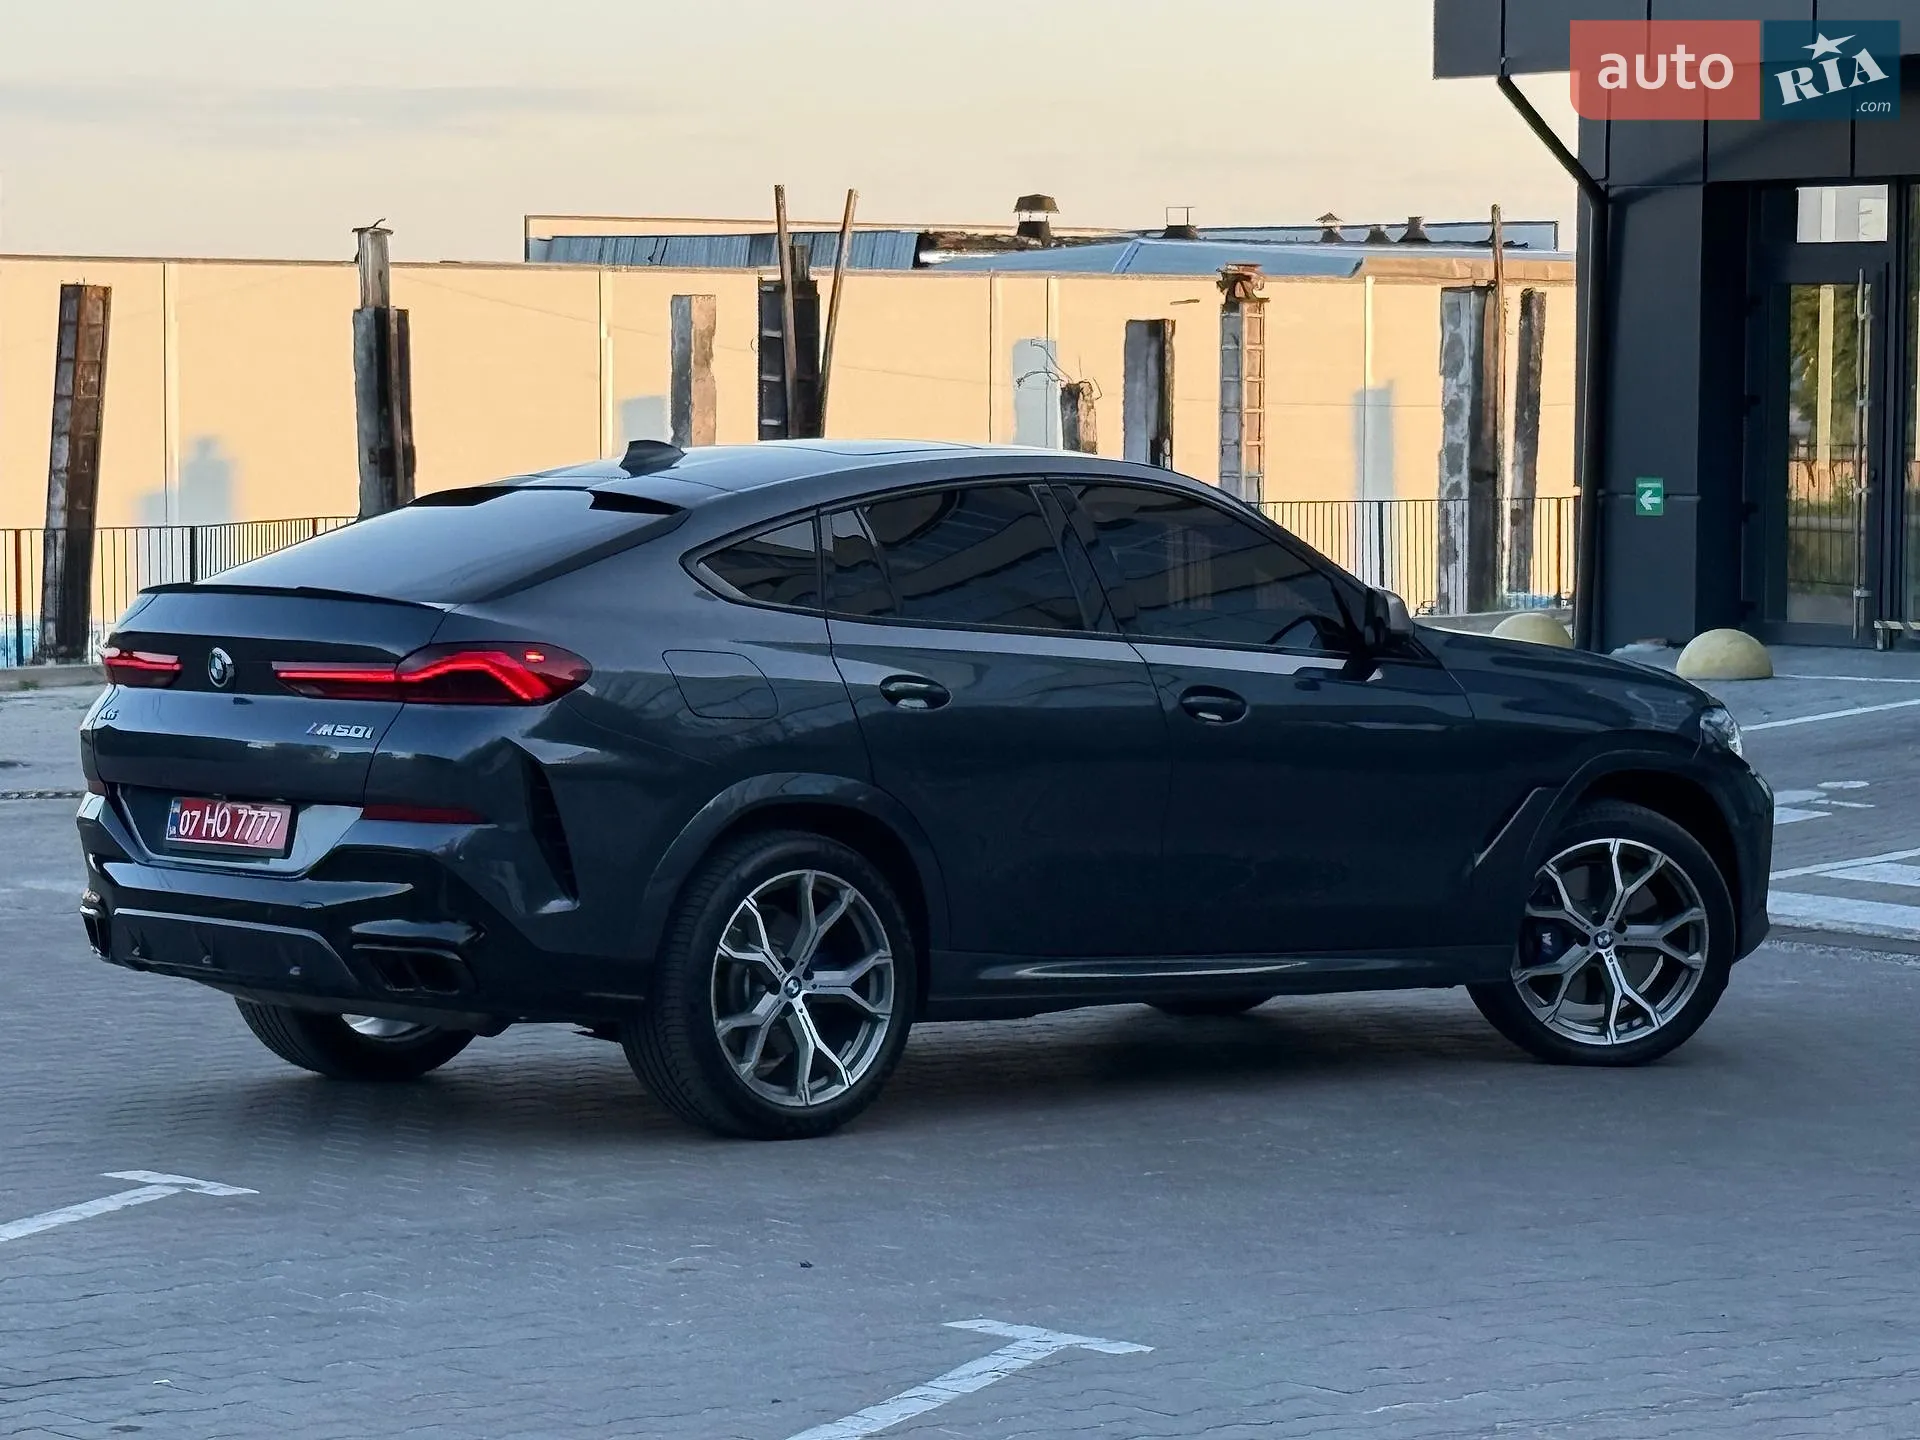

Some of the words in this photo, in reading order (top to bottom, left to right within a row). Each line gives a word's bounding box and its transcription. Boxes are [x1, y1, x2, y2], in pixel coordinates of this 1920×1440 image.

[179, 809, 201, 836] 07
[202, 803, 231, 838] HO
[234, 808, 282, 843] 7777
